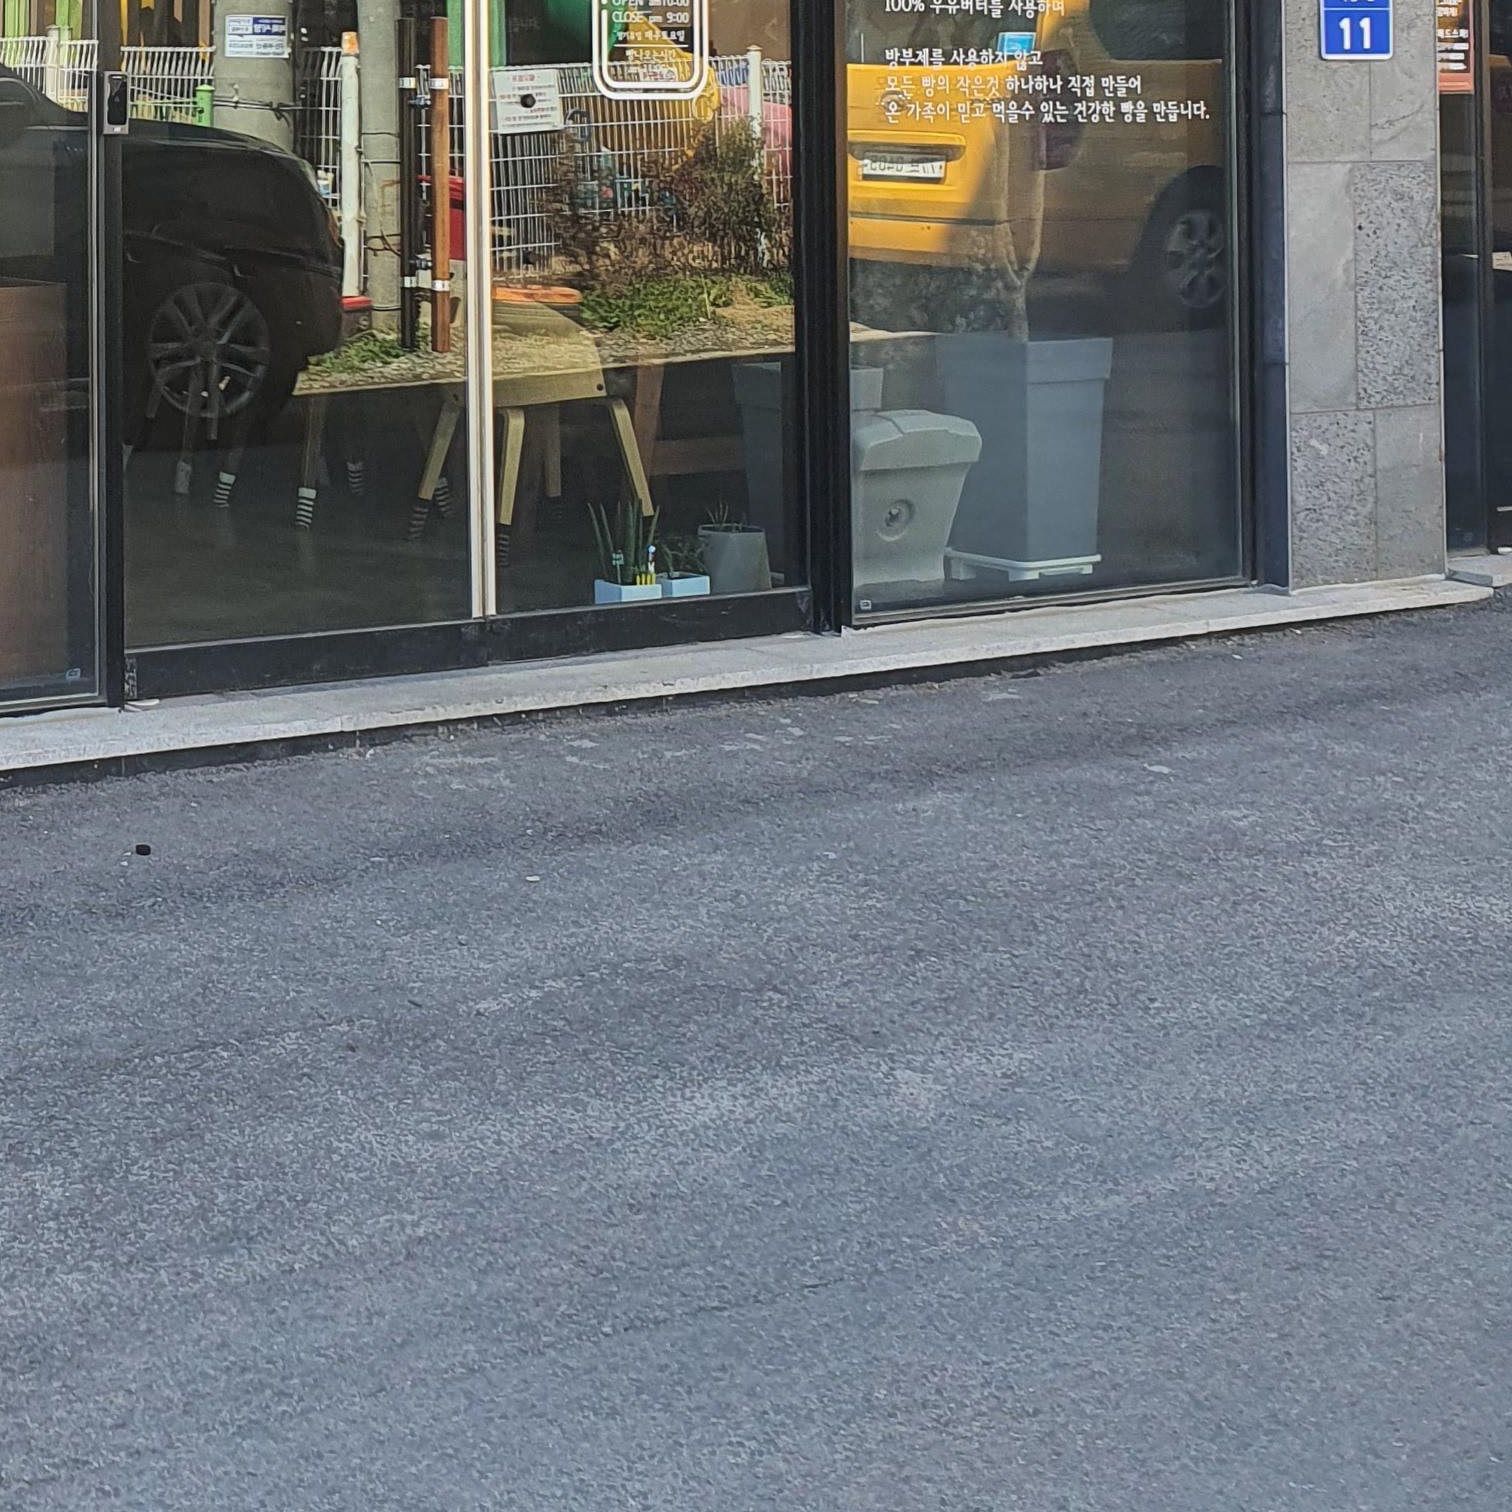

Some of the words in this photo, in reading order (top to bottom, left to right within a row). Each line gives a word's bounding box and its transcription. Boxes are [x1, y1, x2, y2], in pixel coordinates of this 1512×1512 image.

[611, 11, 644, 23] CLOSE
[1339, 17, 1372, 51] 11
[884, 48, 945, 71] 방부제를
[950, 48, 1008, 71] 사용하지
[1014, 49, 1044, 71] 않고
[885, 75, 916, 98] 모든
[921, 74, 950, 97] 빵의
[1005, 75, 1064, 95] 하나하나
[1068, 74, 1095, 97] 직접
[1101, 74, 1142, 97] 만들어
[885, 101, 901, 124] 온
[906, 101, 950, 124] 가족이
[957, 101, 987, 124] 믿고
[992, 101, 1036, 124] 먹을수
[1039, 100, 1069, 124] 있는
[1073, 100, 1116, 123] 건강한
[1120, 100, 1148, 123] 빵을
[1153, 100, 1211, 123] 만듭니다.
